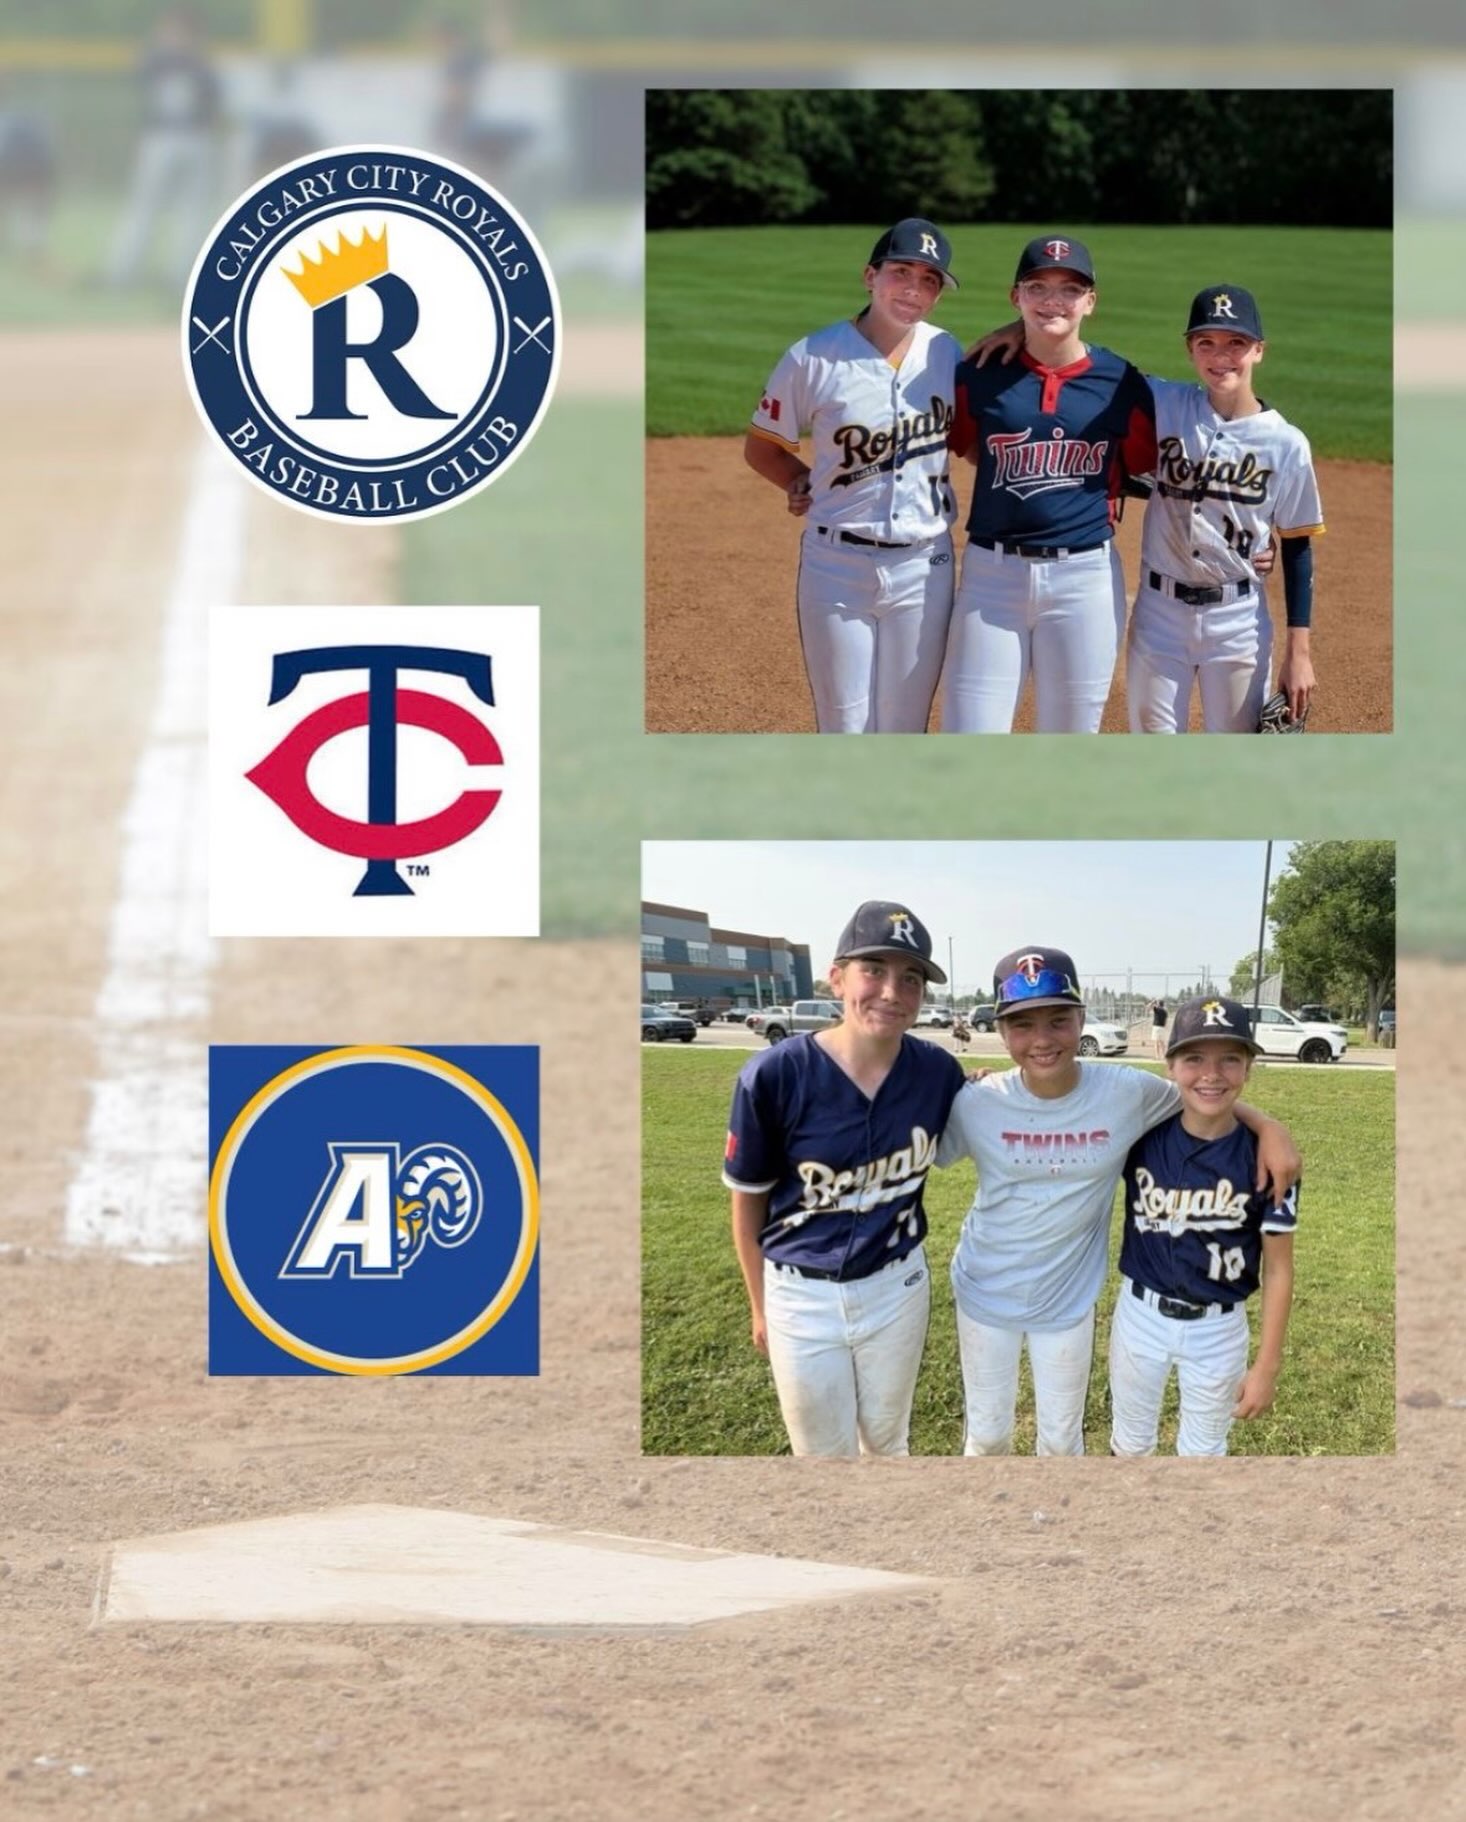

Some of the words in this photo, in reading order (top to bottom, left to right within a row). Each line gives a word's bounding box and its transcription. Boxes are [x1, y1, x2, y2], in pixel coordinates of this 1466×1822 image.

[919, 233, 940, 260] R
[1213, 294, 1238, 319] R
[833, 395, 953, 470] Royals
[986, 426, 1109, 490] Twins
[1158, 436, 1274, 497] Royals
[890, 914, 919, 949] R
[1203, 1002, 1234, 1027] R
[1001, 1129, 1110, 1154] TWINS
[1132, 1166, 1250, 1226] Royals
